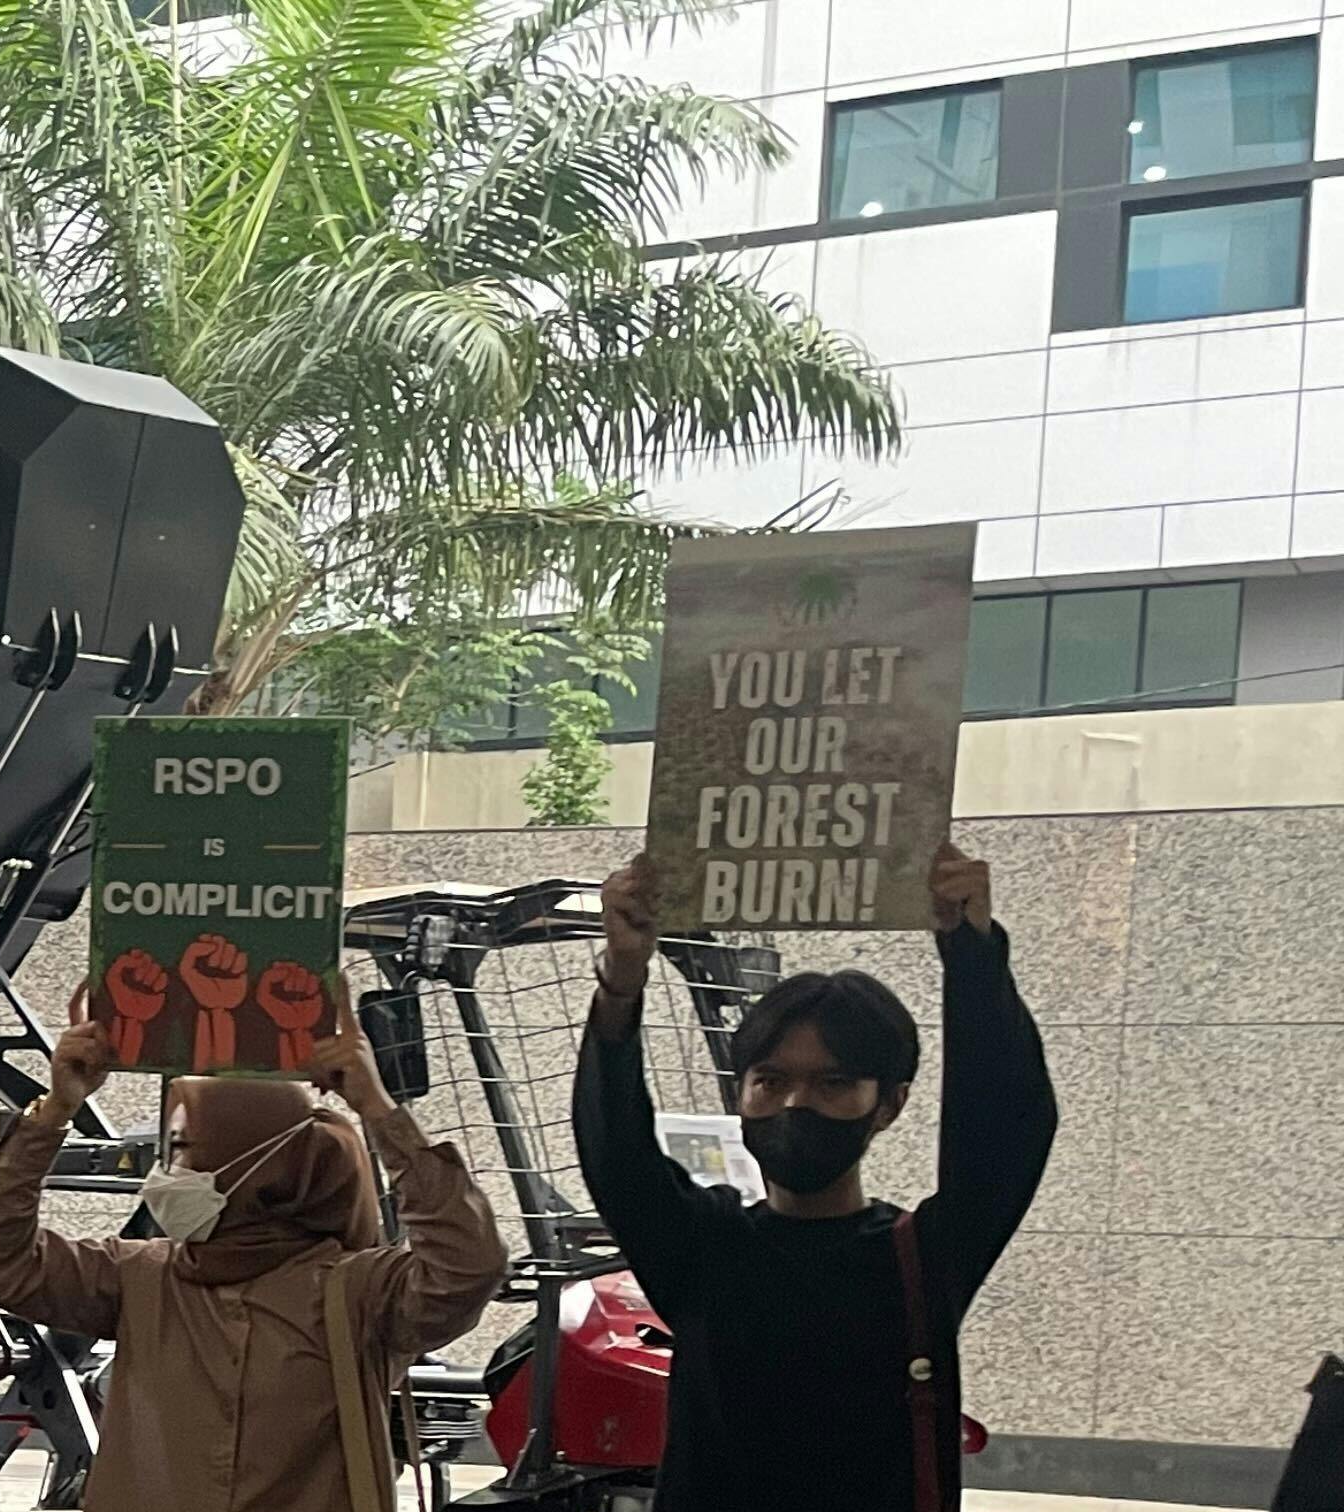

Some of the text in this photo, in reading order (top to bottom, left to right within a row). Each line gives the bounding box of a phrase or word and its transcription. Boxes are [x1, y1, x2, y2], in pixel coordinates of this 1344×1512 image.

[708, 646, 904, 710] YOU LET
[744, 715, 848, 776] OUR
[153, 757, 283, 796] RSPO
[696, 781, 902, 850] FOREST
[202, 838, 226, 857] IS
[102, 881, 335, 919] COMPLICIT
[701, 857, 881, 924] BURN!
